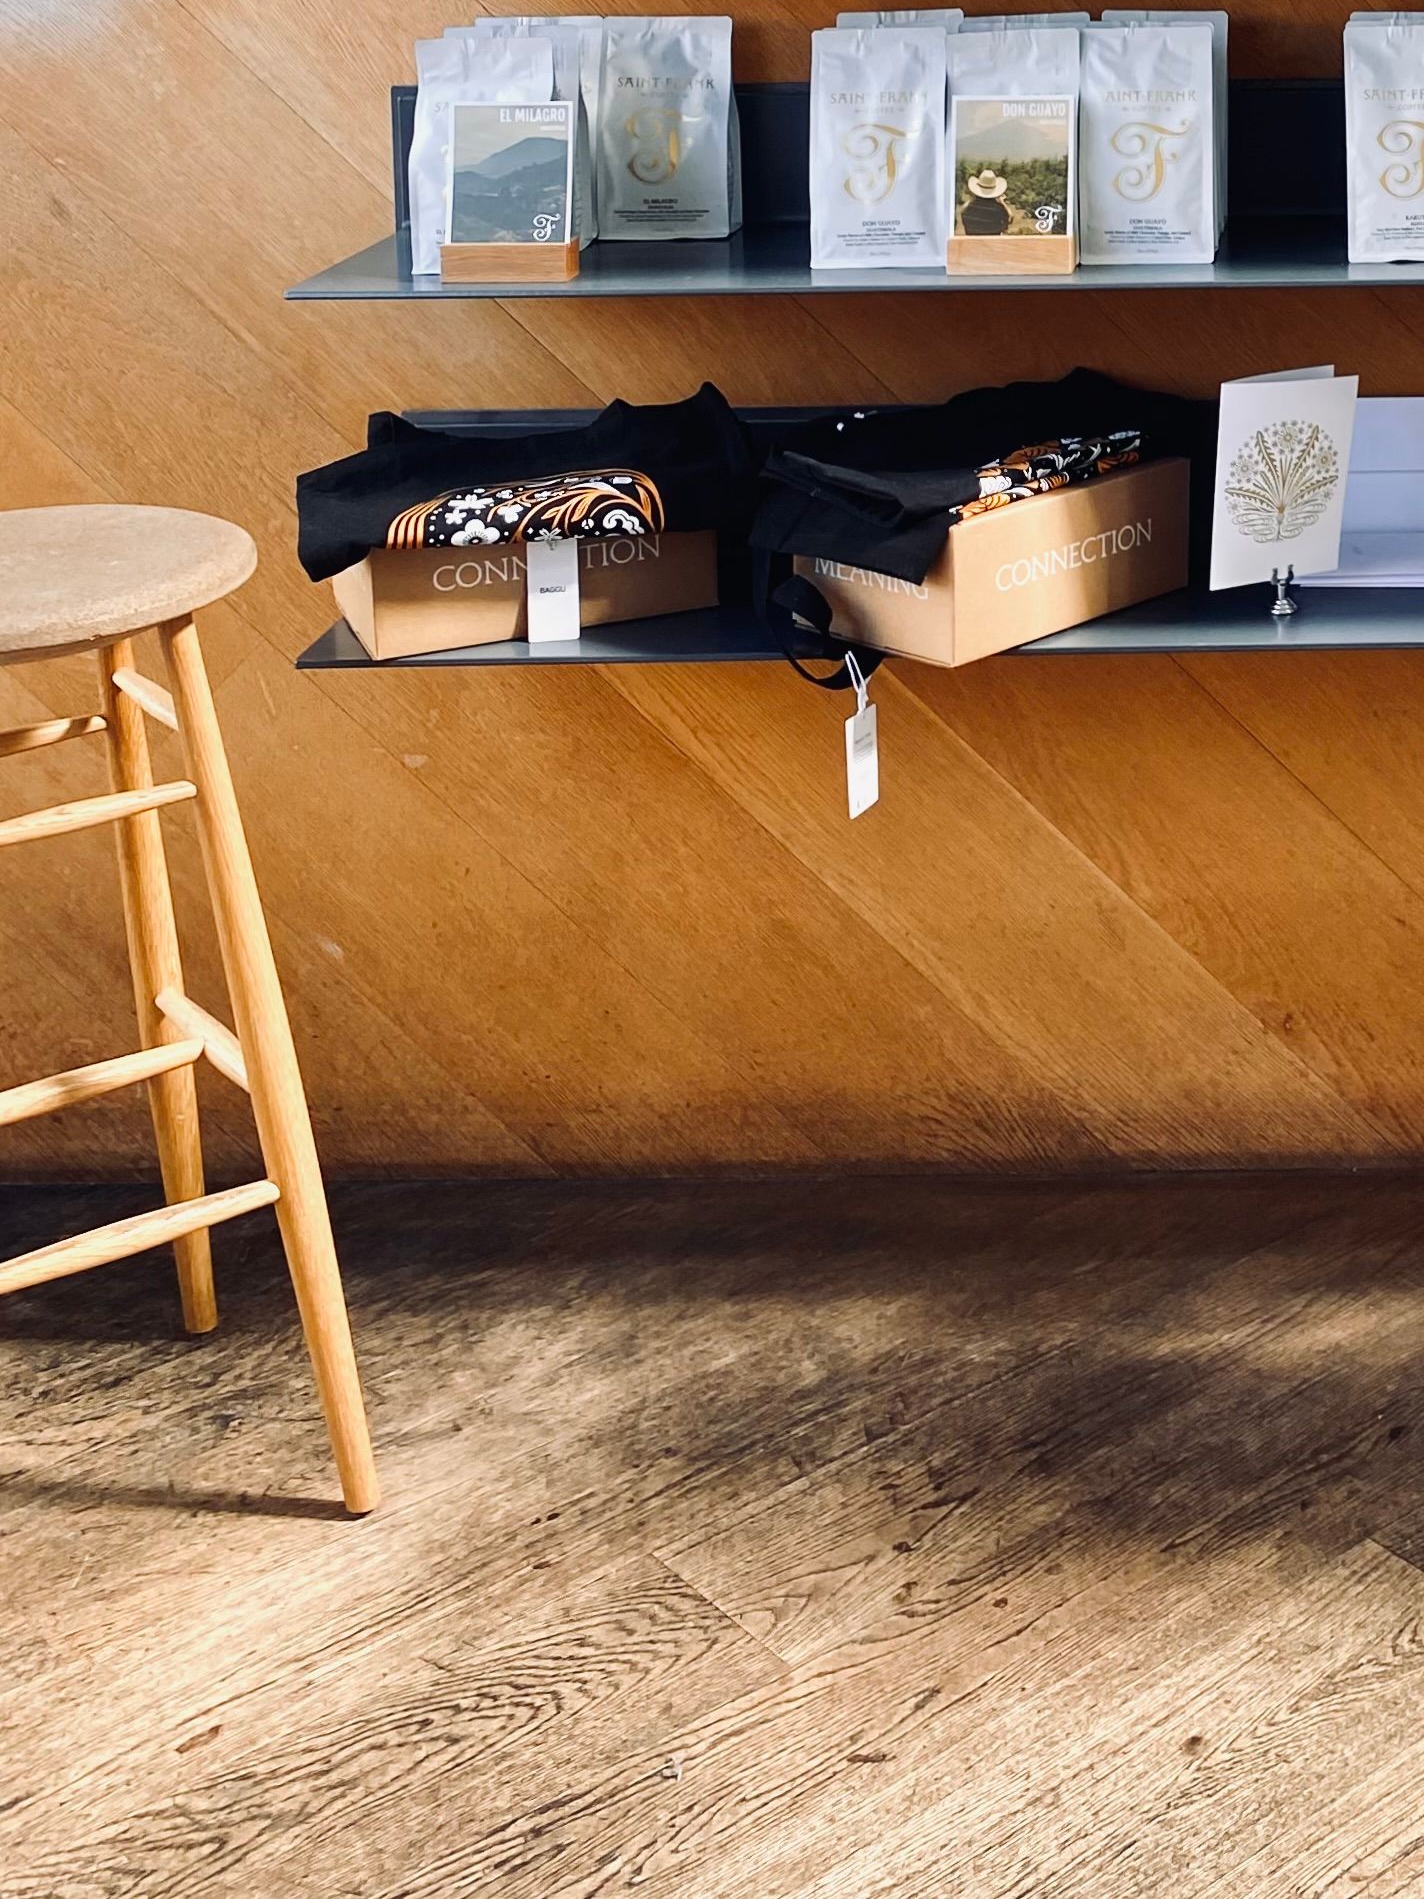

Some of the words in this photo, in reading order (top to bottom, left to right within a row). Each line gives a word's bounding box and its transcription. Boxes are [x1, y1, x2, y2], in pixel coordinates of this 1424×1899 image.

[1147, 90, 1198, 102] FRANK
[1364, 88, 1407, 100] SAINT
[500, 108, 513, 122] EL
[515, 108, 566, 122] MILAGRO
[1003, 102, 1026, 117] DON
[1029, 102, 1066, 117] GUAYO
[995, 518, 1153, 592] CONNECTION
[433, 534, 661, 592] CONNTION
[539, 585, 567, 594] BAGGU
